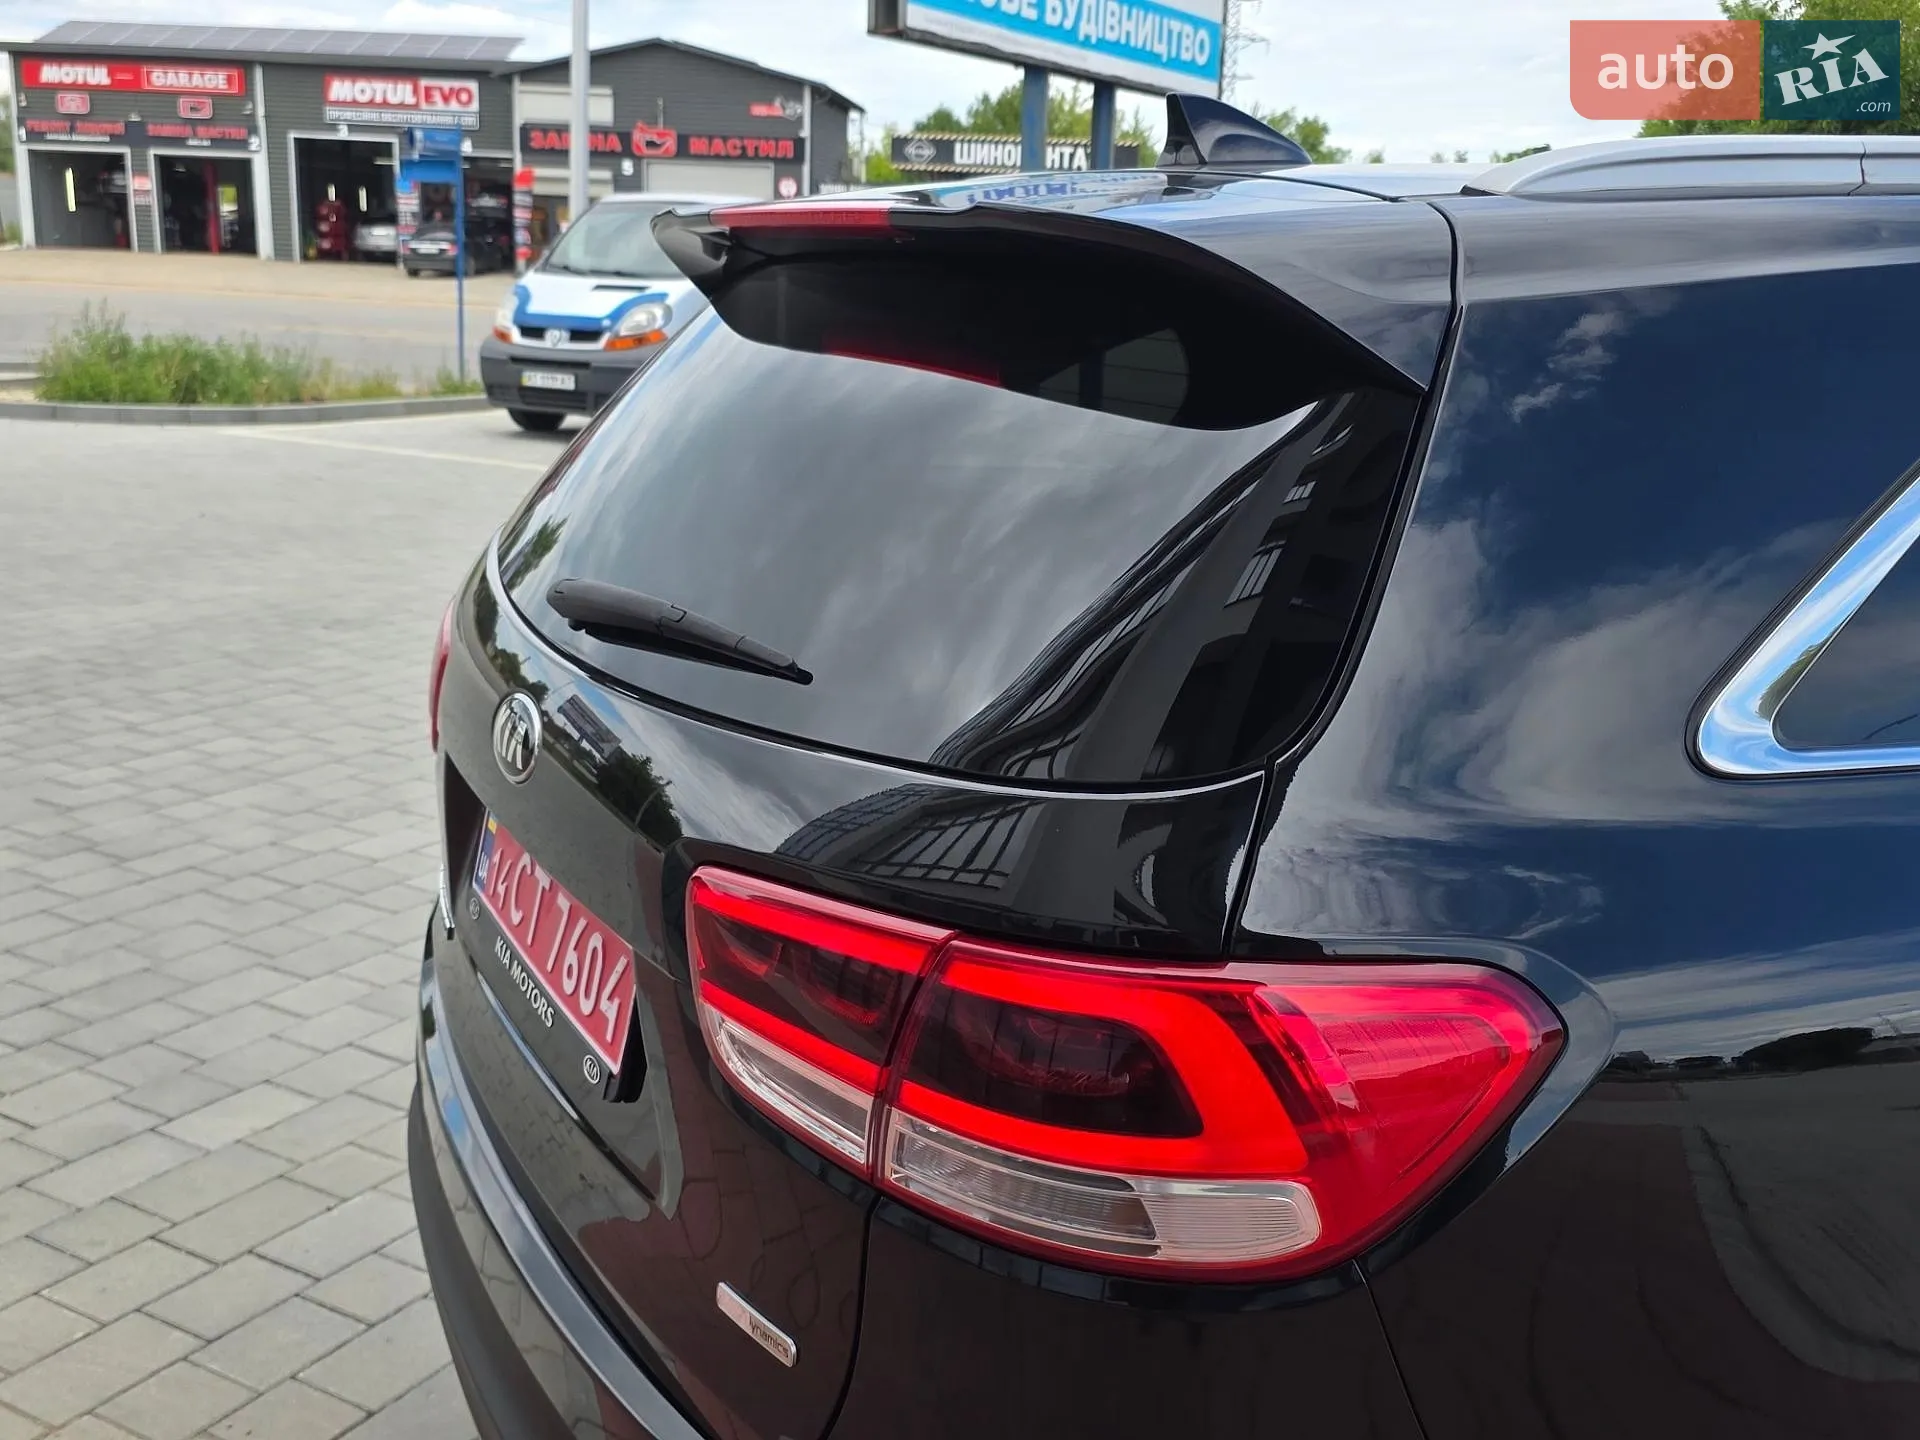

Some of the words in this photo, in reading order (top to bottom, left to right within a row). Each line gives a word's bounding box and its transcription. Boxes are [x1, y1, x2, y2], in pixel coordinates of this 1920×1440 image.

[1045, 0, 1210, 66] БУДІВНИЦТВО
[40, 64, 111, 86] MOTUL
[151, 71, 229, 89] GARAGE
[329, 79, 416, 105] MOTUL
[424, 86, 473, 106] EVO
[530, 130, 622, 153] ЗАНА
[689, 137, 794, 159] МАСТИЛ
[954, 142, 1092, 171] ШИНОНТА
[489, 847, 512, 911] 14
[510, 852, 553, 948] CT
[547, 894, 629, 1043] 7604
[495, 936, 511, 972] KIA
[510, 966, 555, 1028] MOTORS
